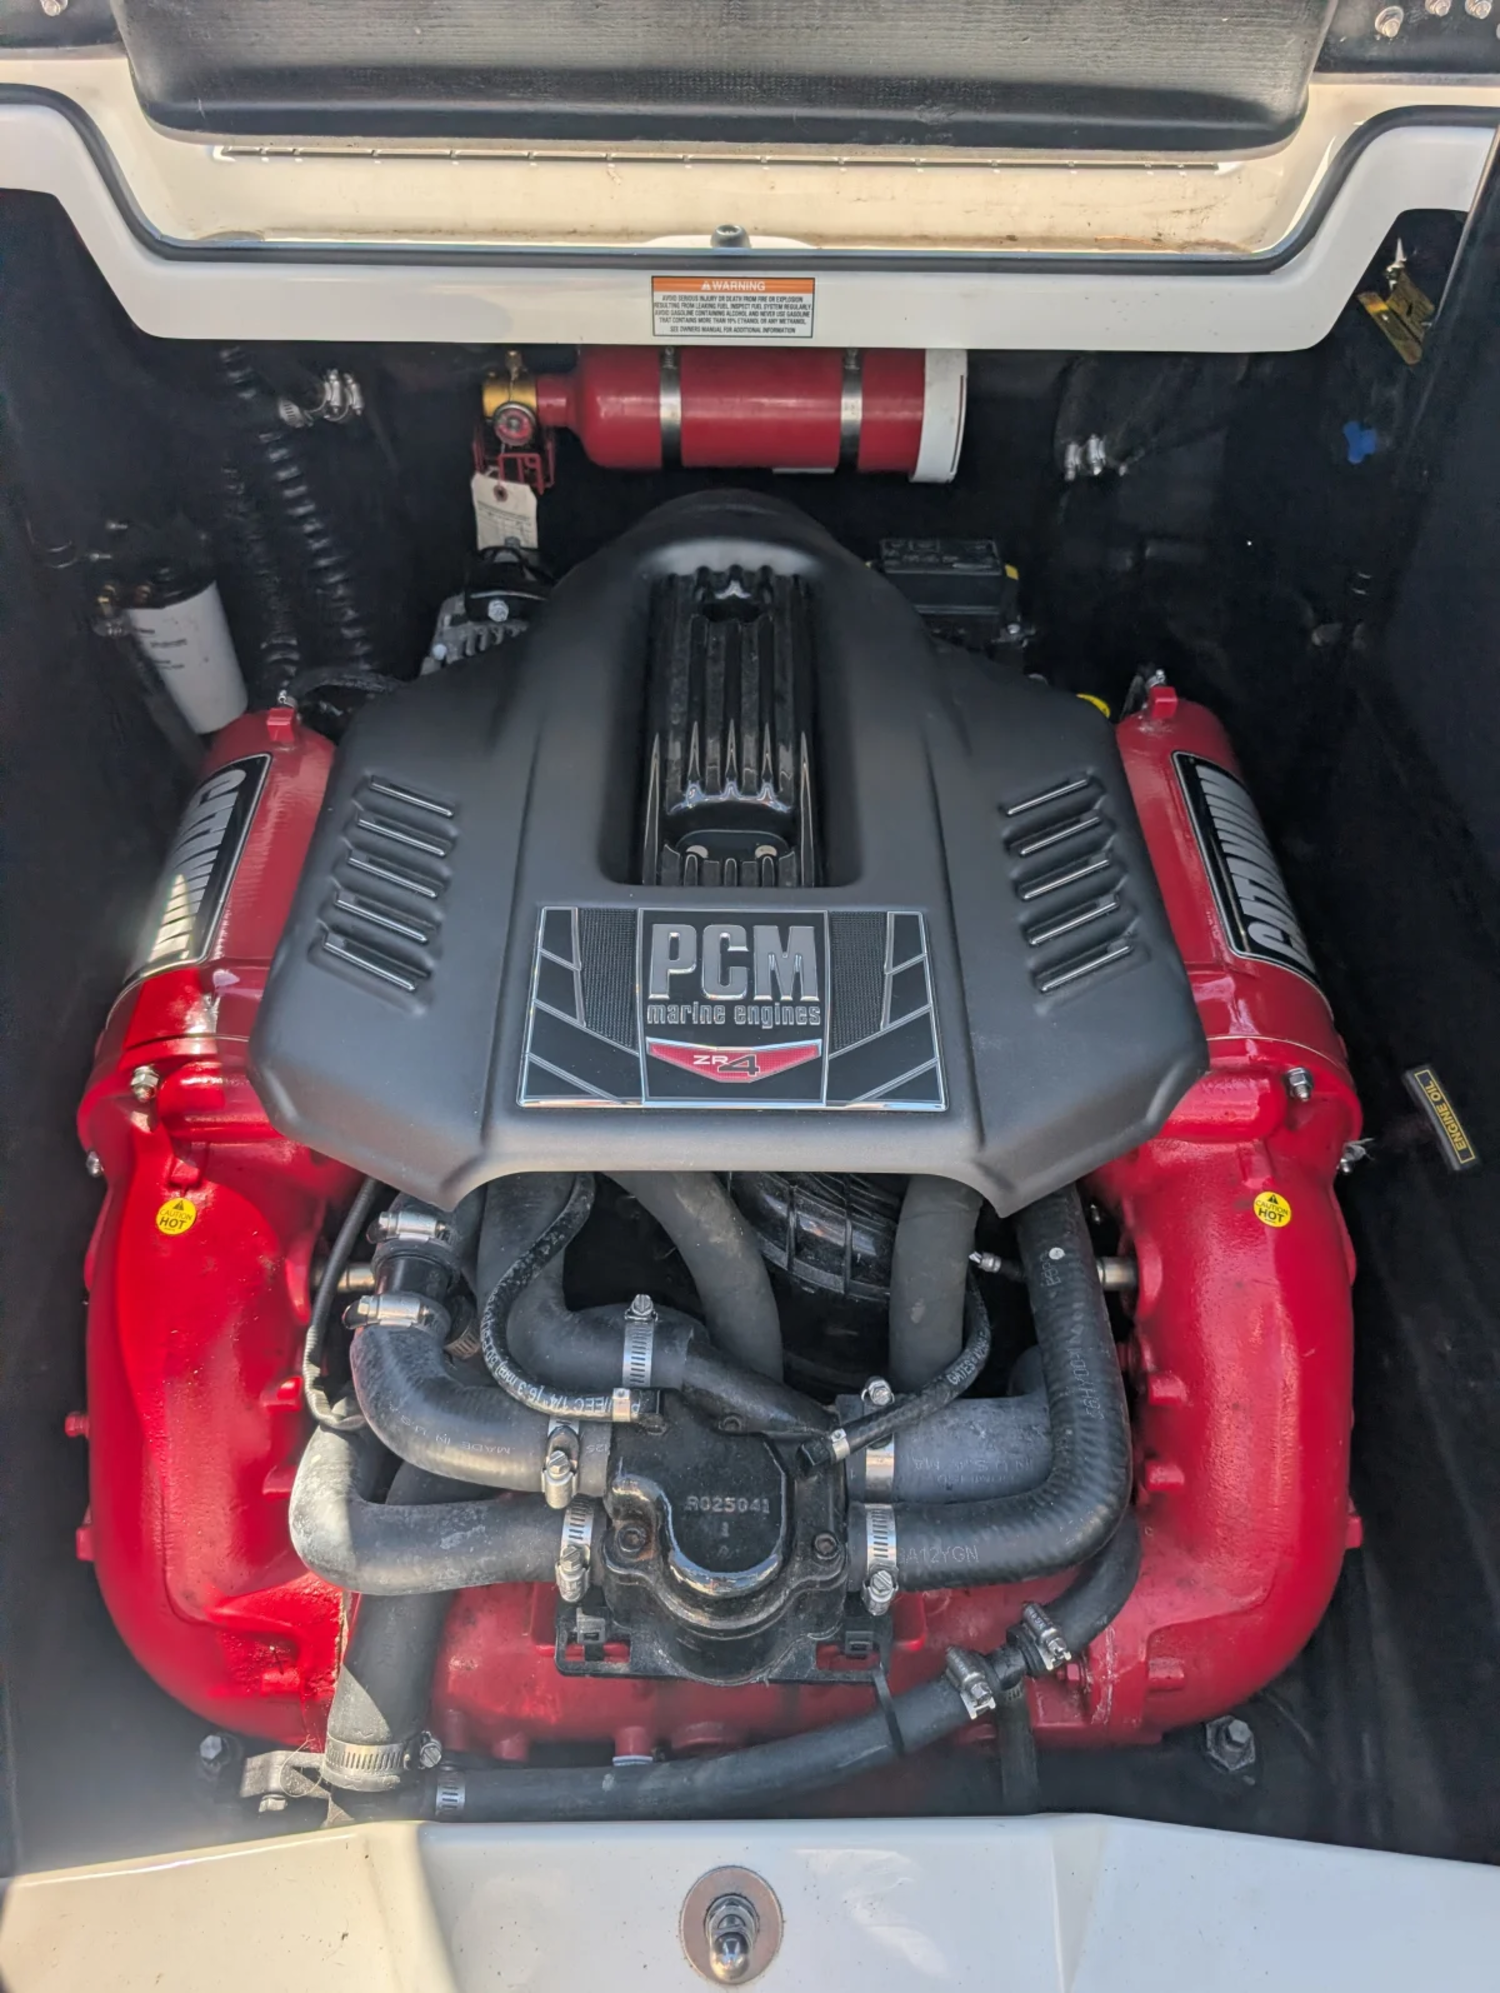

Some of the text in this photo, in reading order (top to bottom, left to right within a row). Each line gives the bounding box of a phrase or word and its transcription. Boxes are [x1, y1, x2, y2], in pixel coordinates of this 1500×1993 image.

[712, 280, 766, 291] WARNING
[647, 922, 820, 1002] PCM
[646, 1001, 822, 1029] marine engines
[692, 1053, 760, 1077] ZR4
[1425, 1080, 1467, 1151] ENGINE OIL
[159, 1208, 193, 1221] CAUTION
[1255, 1200, 1289, 1216] CAUTION
[1258, 1207, 1285, 1223] HOT
[159, 1216, 188, 1230] HOT
